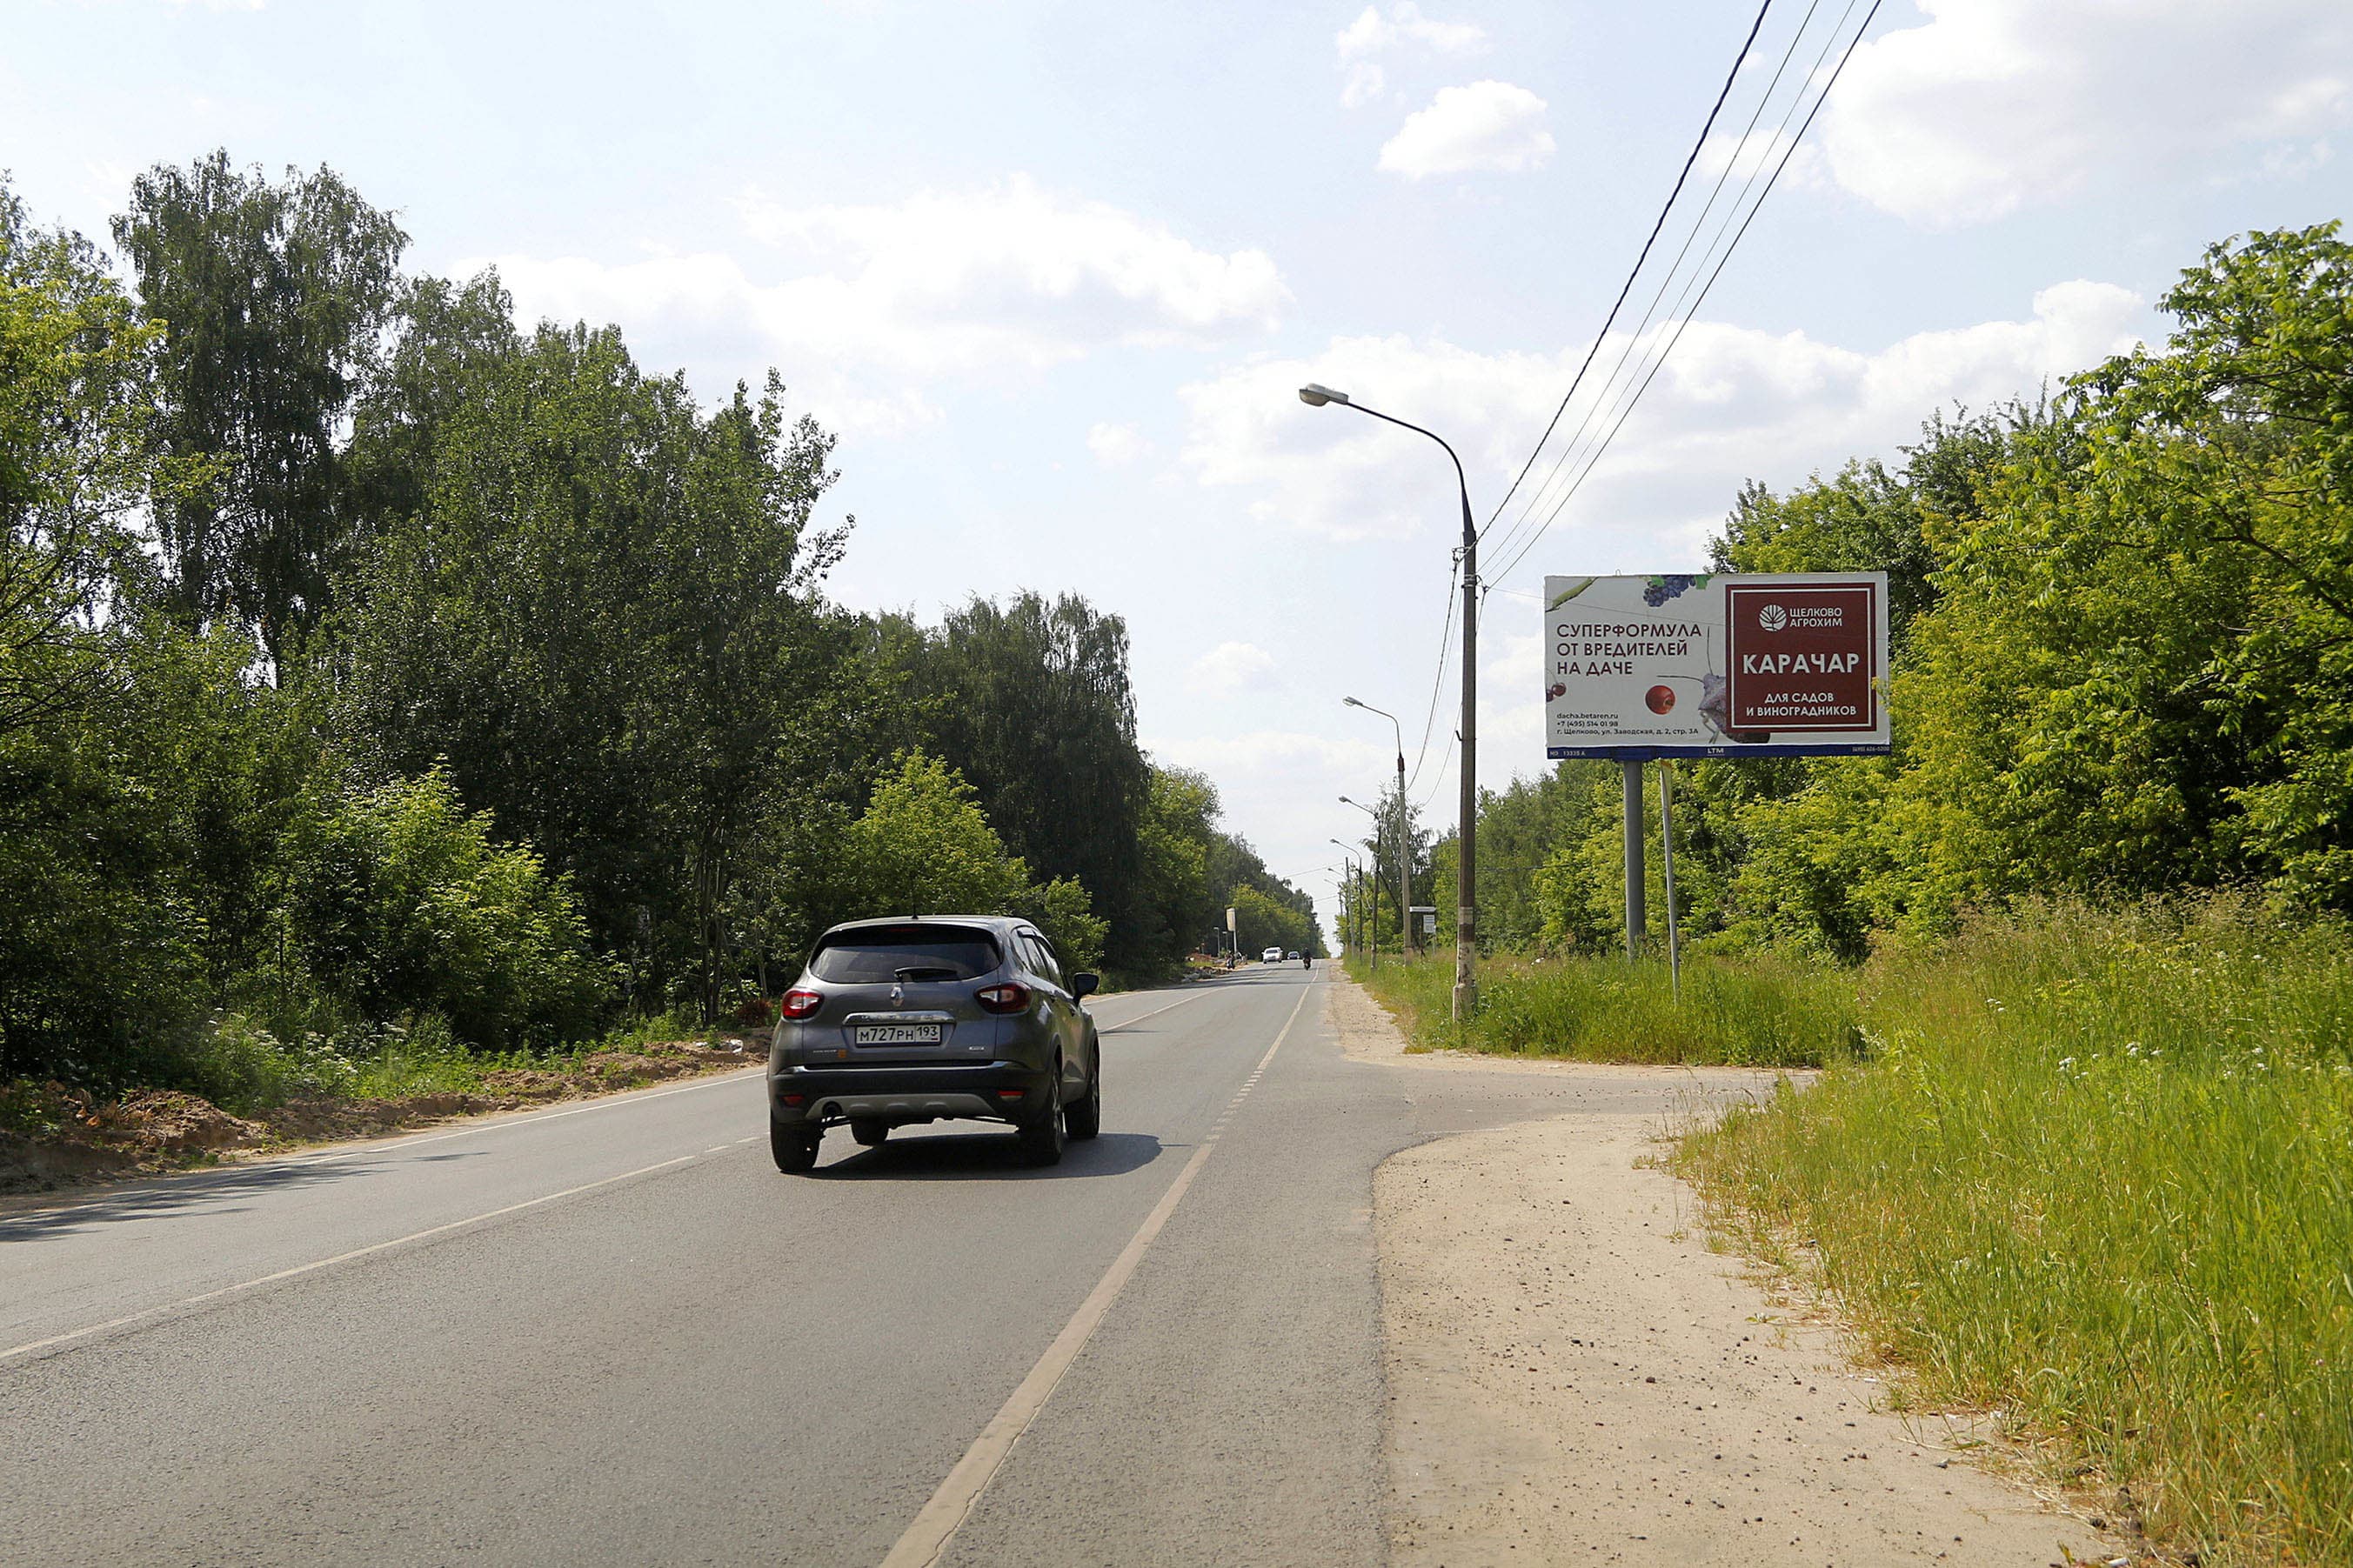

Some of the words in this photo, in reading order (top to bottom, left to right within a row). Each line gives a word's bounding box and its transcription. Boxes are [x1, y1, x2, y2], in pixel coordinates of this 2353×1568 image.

[1789, 607, 1842, 617] ЩЕЛКОВО
[1789, 618, 1842, 627] АГРОХИМ
[1556, 624, 1701, 637] СУПЕРФОРМУЛА
[1556, 643, 1578, 656] ОТ
[1584, 639, 1688, 657] ВРЕДИТЕЛЕЙ
[1557, 661, 1581, 674] НА
[1586, 661, 1633, 676] ДАЧЕ
[1742, 653, 1860, 674] КАРАЧАР
[1764, 693, 1788, 704] ДЛЯ
[1791, 692, 1835, 704] САДОВ
[1746, 707, 1754, 716] И
[1757, 706, 1857, 717] ВИНОГРАДНИКОВ
[859, 1027, 913, 1042] М727РН
[916, 1026, 937, 1037] 193
